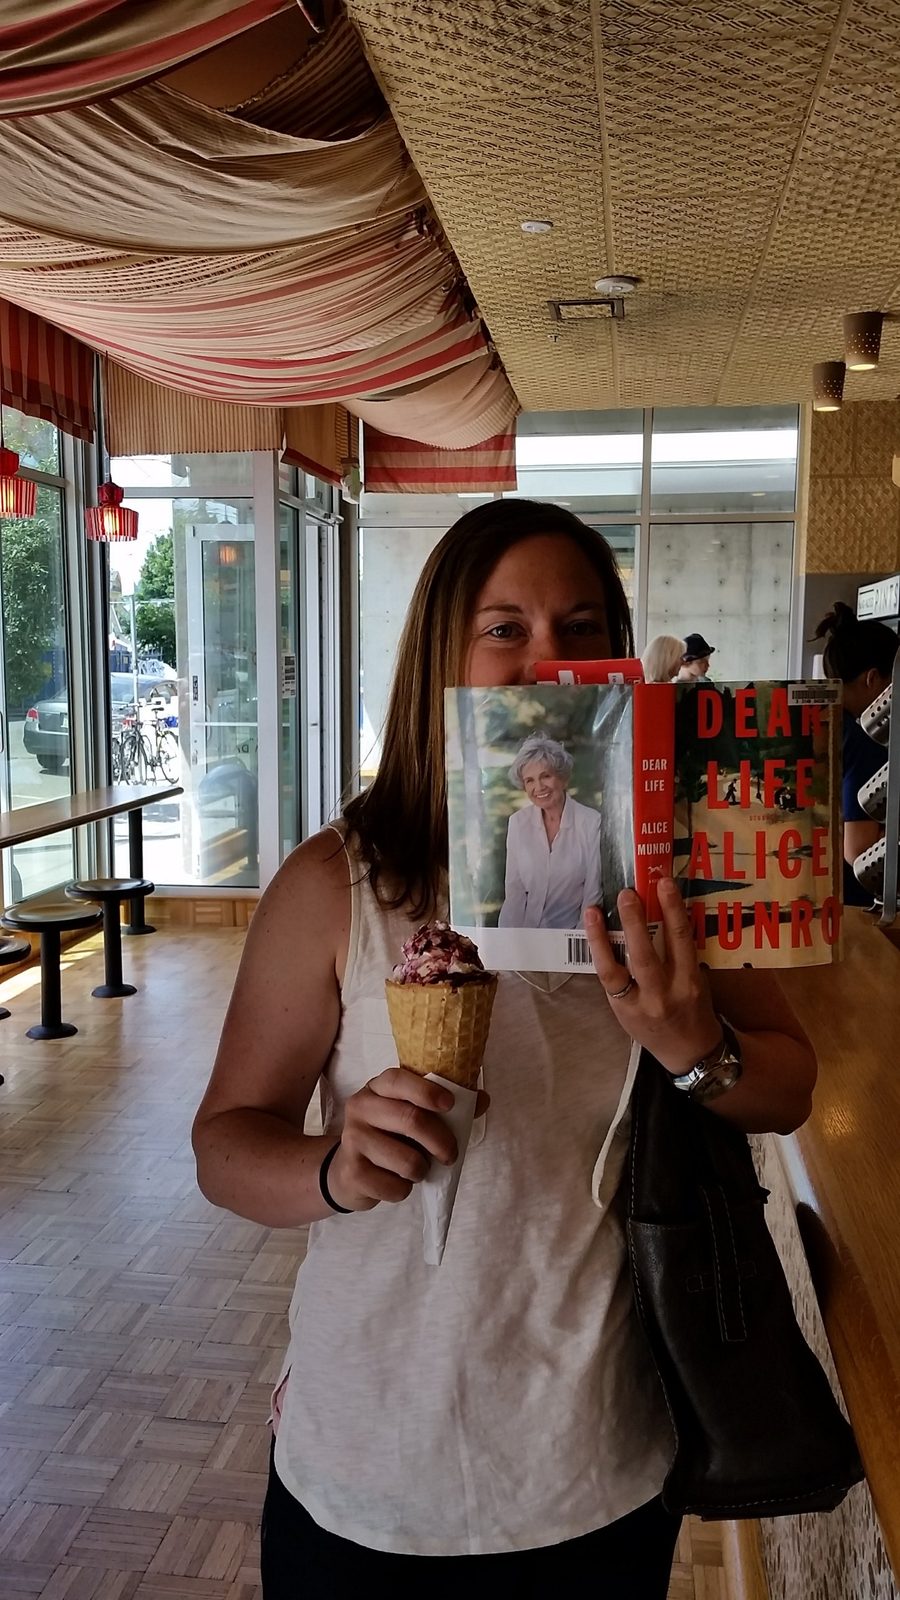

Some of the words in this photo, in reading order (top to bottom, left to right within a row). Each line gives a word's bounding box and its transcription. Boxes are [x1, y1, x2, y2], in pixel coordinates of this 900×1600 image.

[697, 687, 823, 739] DEAR
[642, 759, 667, 771] DEAR
[644, 780, 665, 792] LIFE
[707, 758, 816, 809] LIFE
[641, 821, 668, 835] ALICE
[637, 842, 671, 856] MUNRO
[688, 828, 829, 880] ALICE
